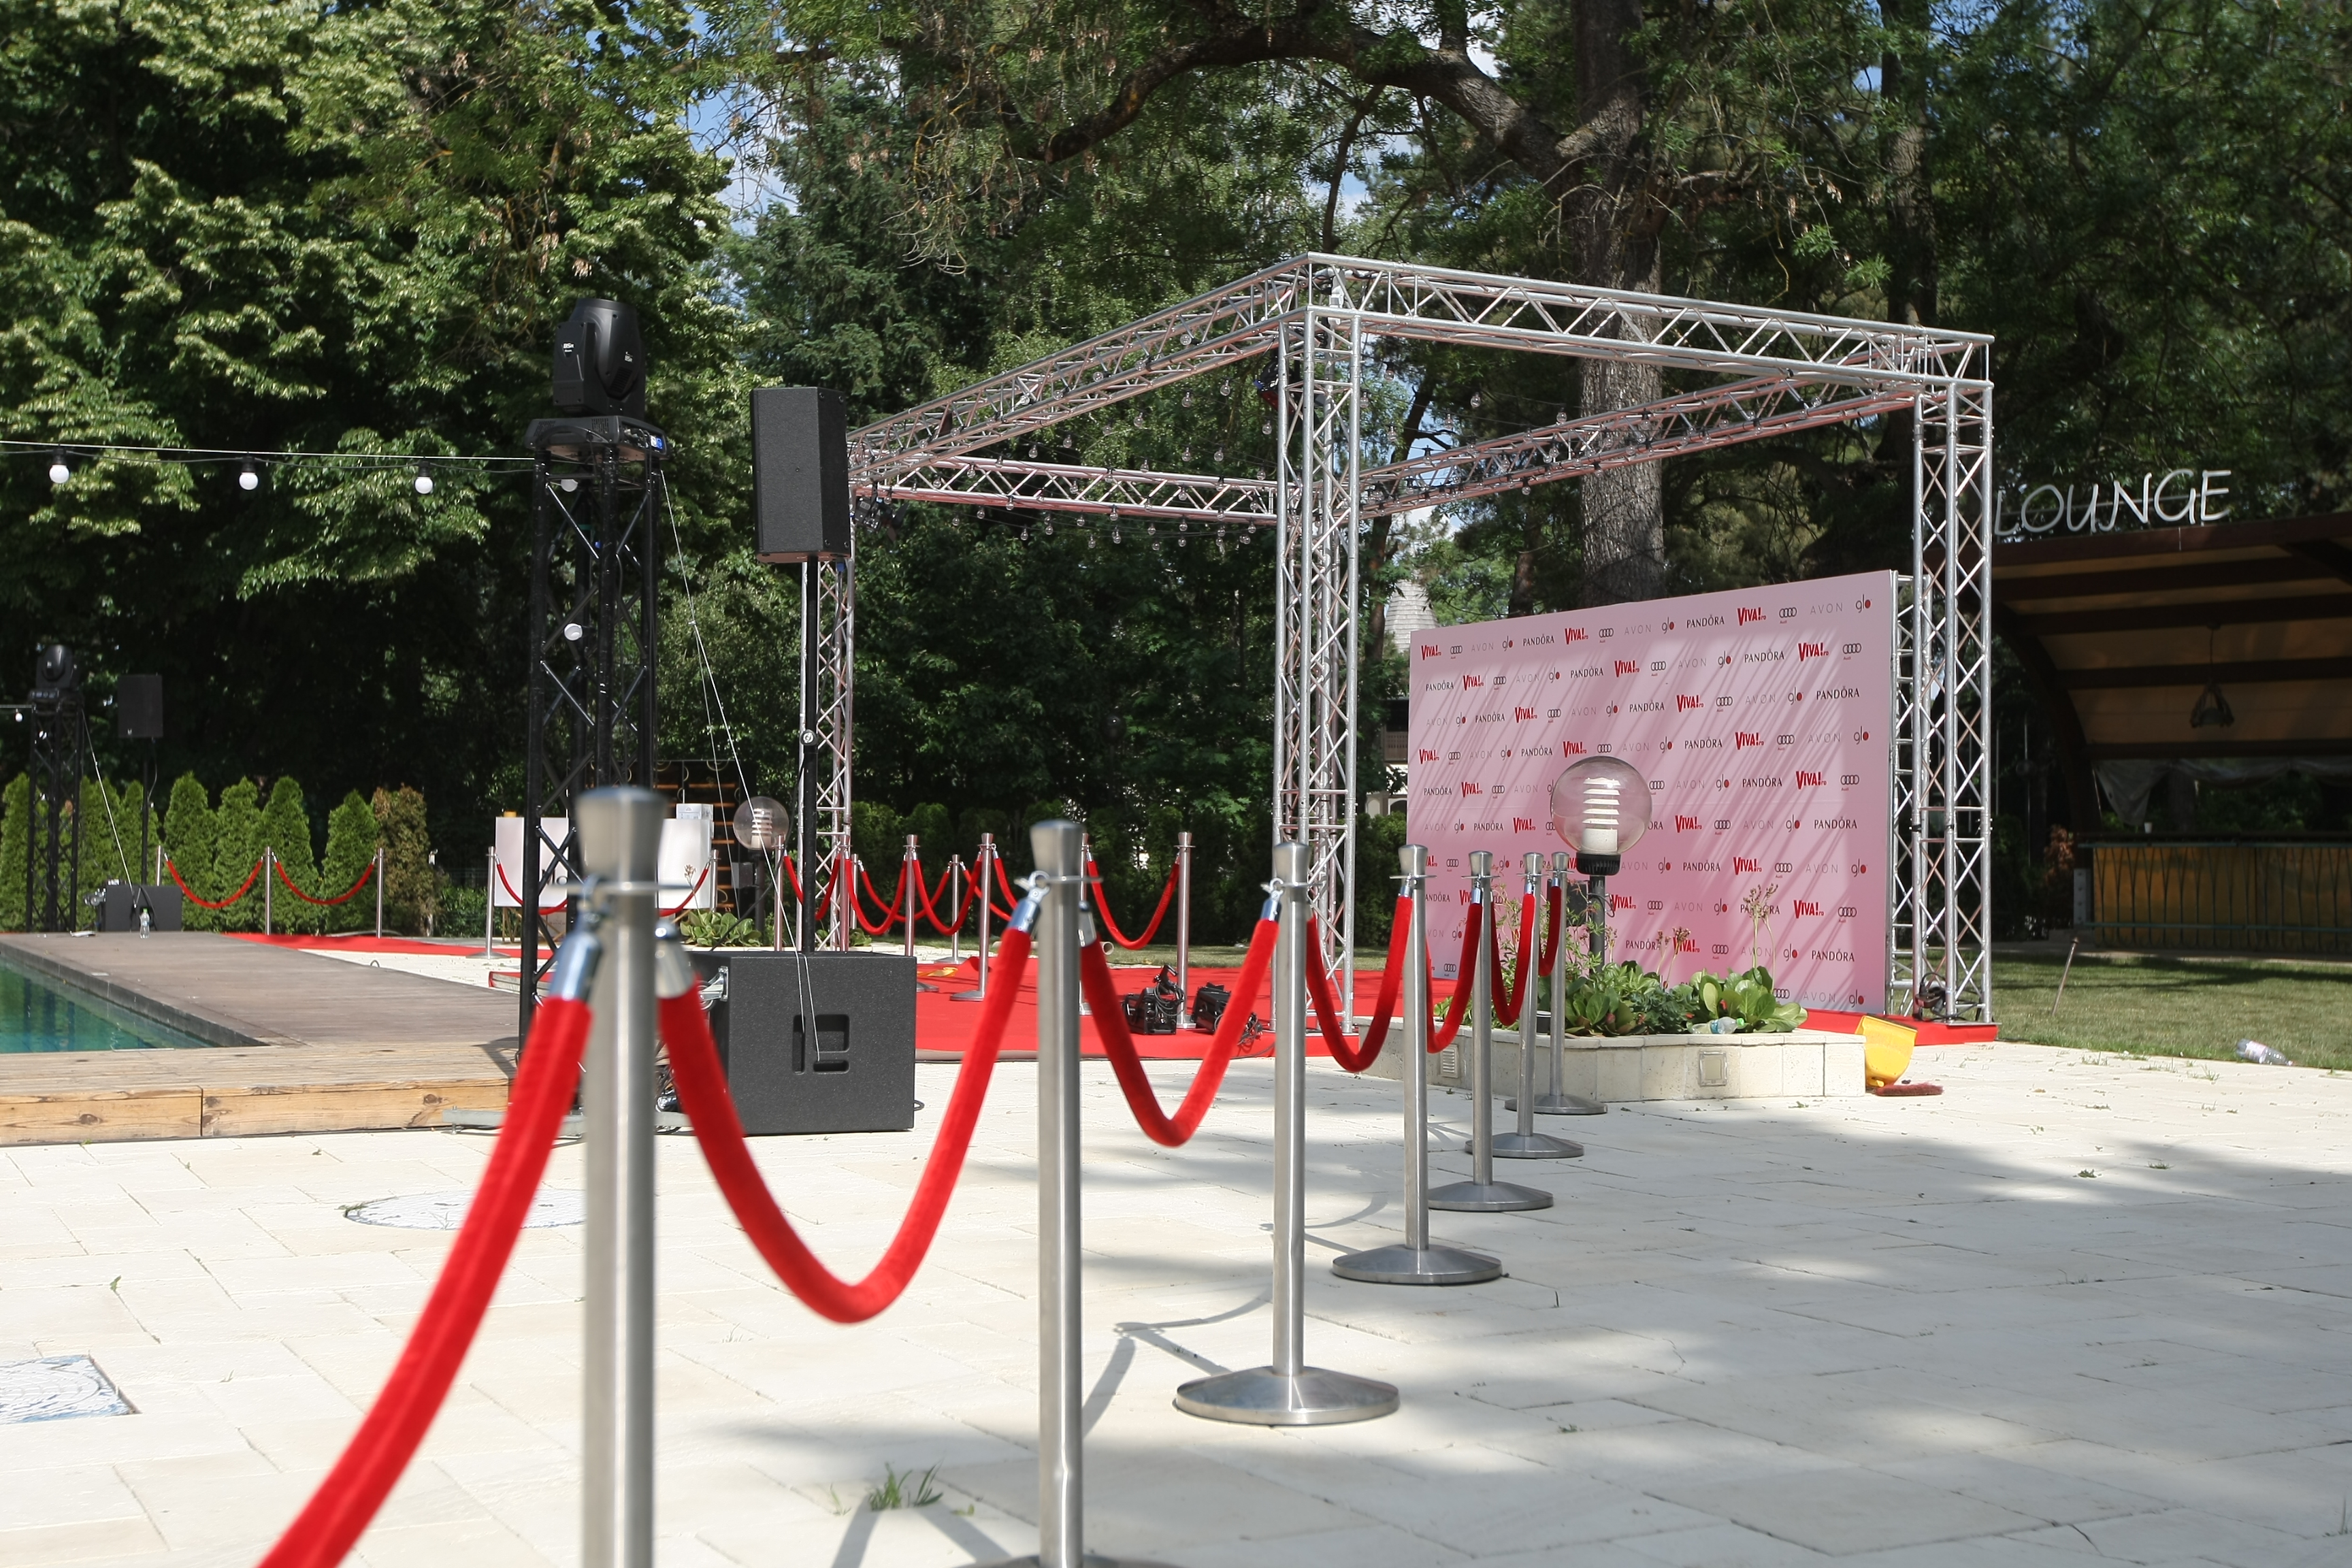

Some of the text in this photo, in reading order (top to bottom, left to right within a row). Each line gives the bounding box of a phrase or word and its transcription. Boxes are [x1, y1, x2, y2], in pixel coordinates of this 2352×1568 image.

[1994, 469, 2232, 536] LOUNGE
[1471, 642, 1494, 652] AVON
[1624, 625, 1651, 635] AVON
[1810, 603, 1842, 615] AVON
[1516, 674, 1540, 683] AVON
[1678, 658, 1706, 668] AVON
[1571, 707, 1596, 715] AVON
[1745, 694, 1776, 704] AVON
[1469, 751, 1492, 759] AVON
[1623, 743, 1649, 751] AVON
[1808, 733, 1840, 743] AVON
[1514, 785, 1538, 793] AVON
[1676, 781, 1704, 789] AVON
[1744, 821, 1774, 829] AVON
[1621, 862, 1648, 870] AVON
[1806, 864, 1838, 873] AVON
[1426, 892, 1450, 902] ANDORA
[1675, 902, 1703, 911] AVON
[1428, 930, 1443, 938] VON
[1803, 992, 1835, 1002] AVON
